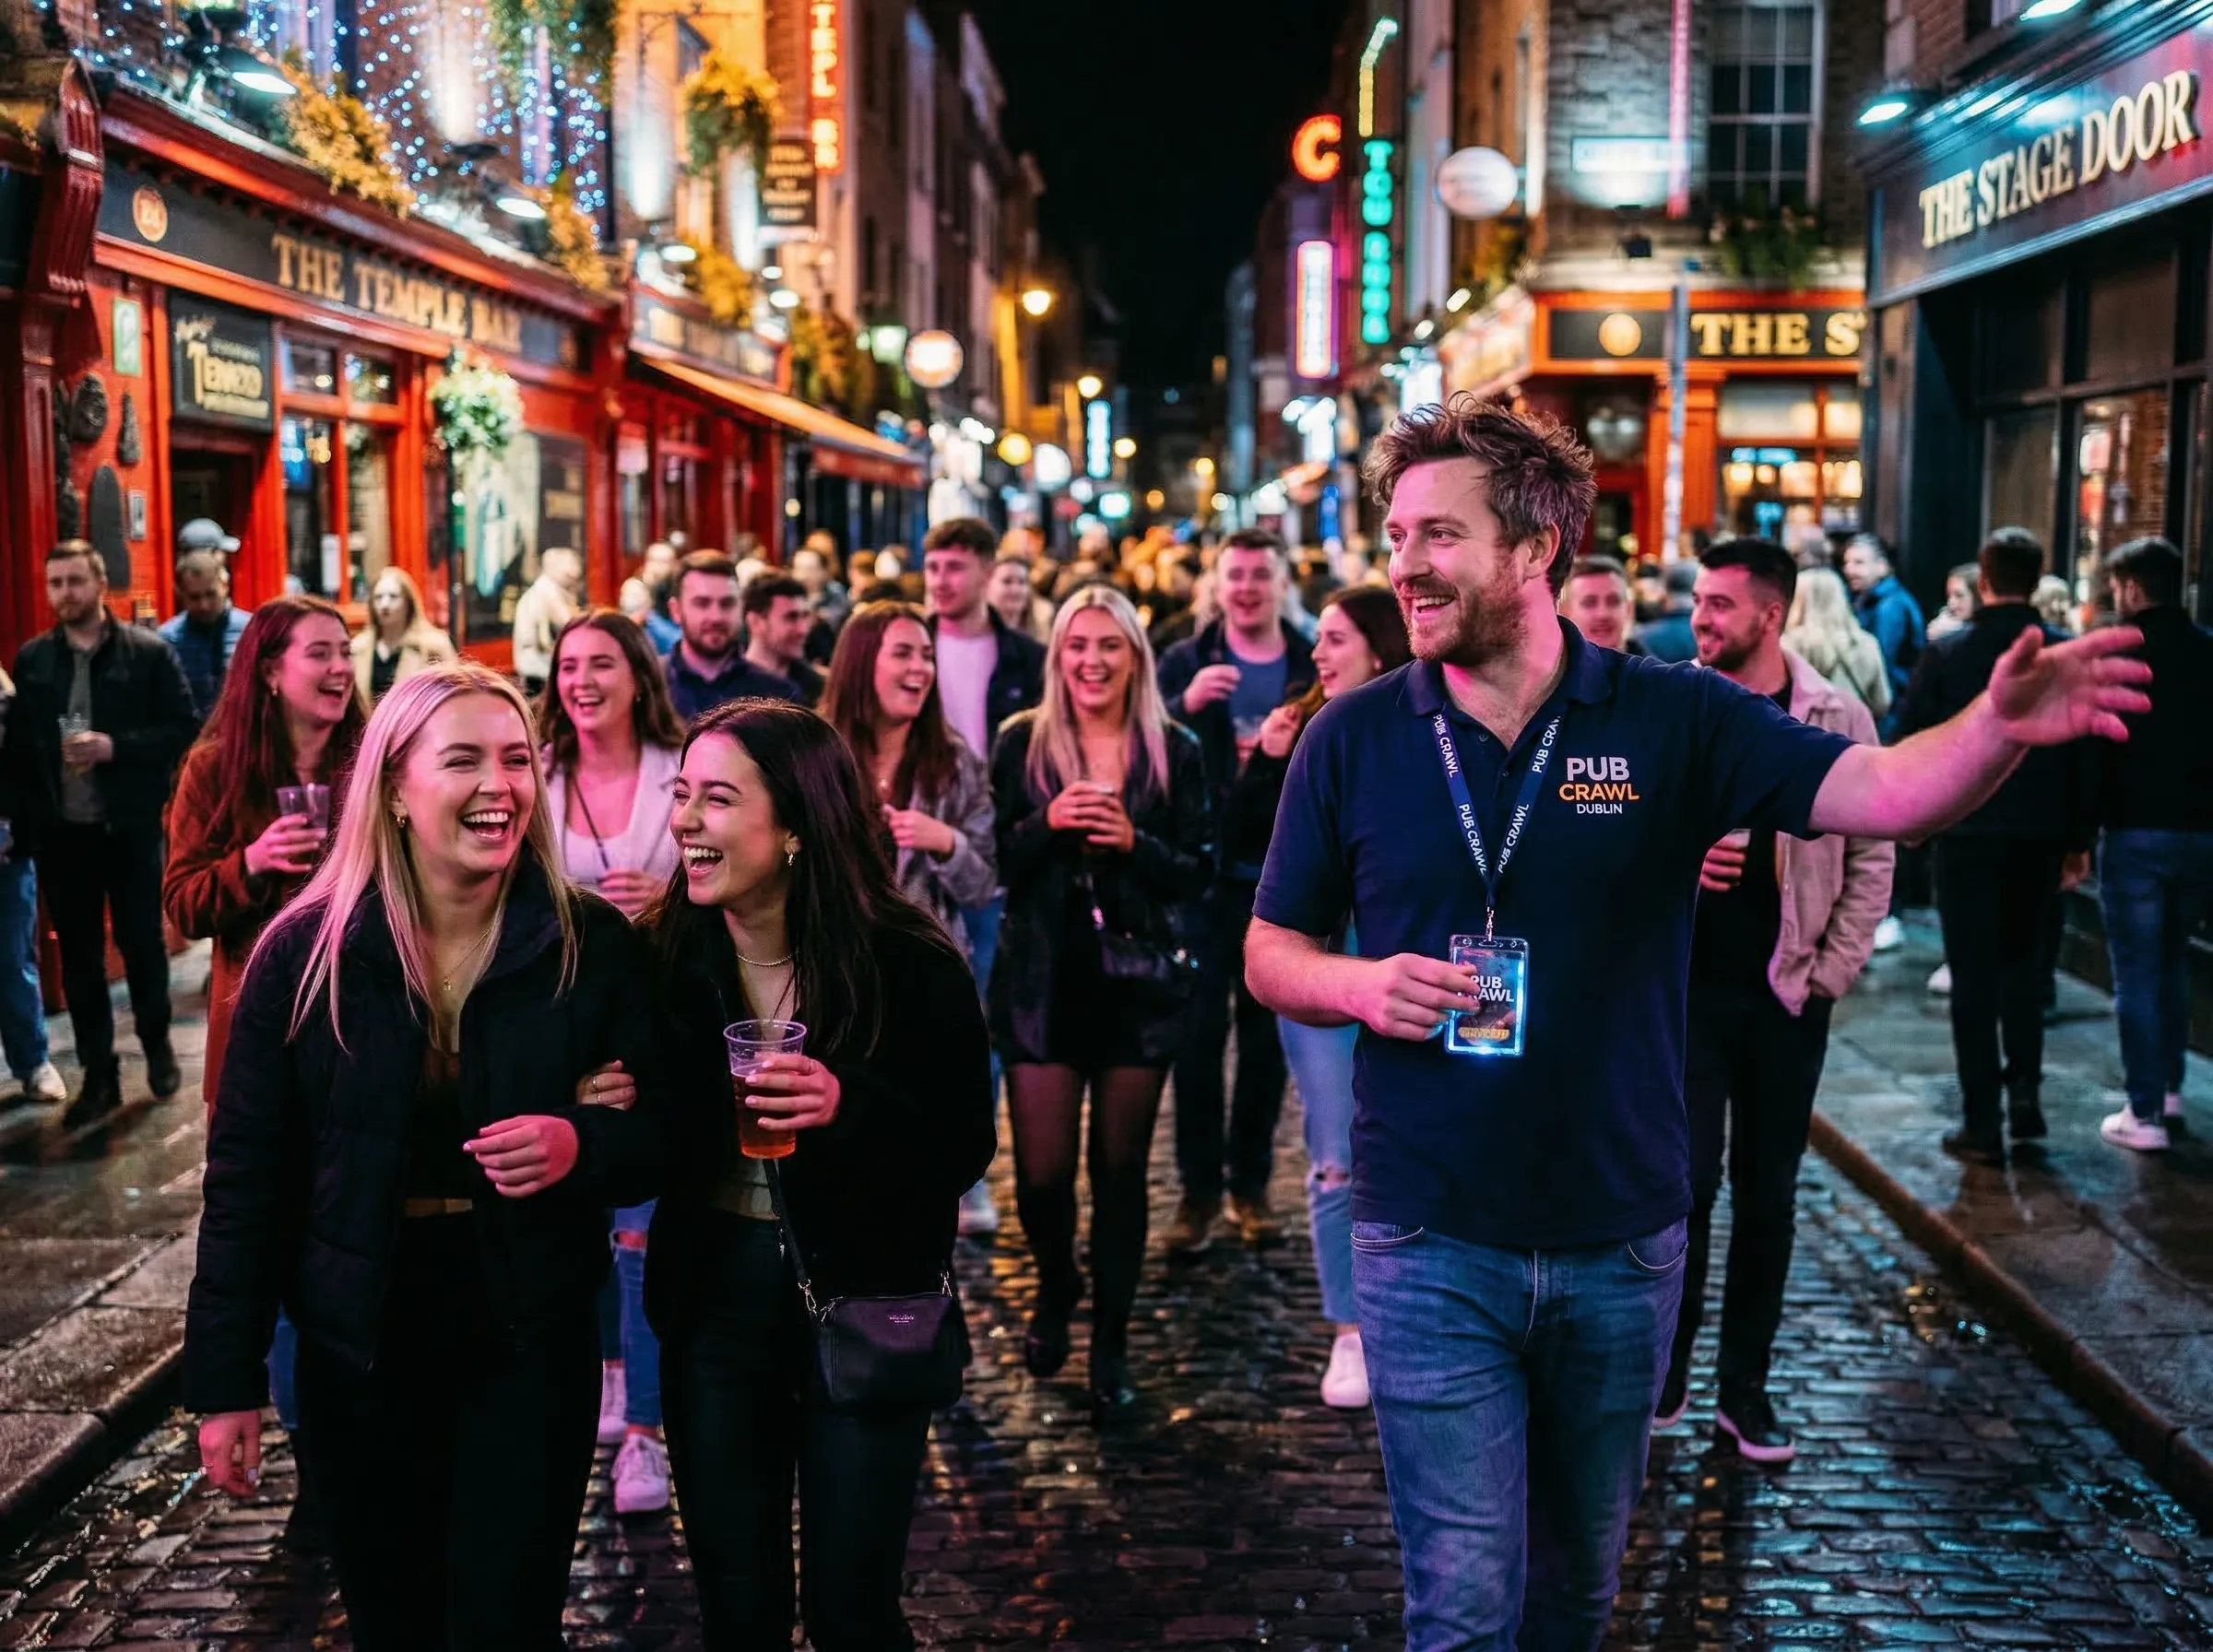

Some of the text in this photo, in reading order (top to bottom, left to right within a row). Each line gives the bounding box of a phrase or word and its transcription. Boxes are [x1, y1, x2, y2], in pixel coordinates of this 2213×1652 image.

[1919, 70, 2195, 249] THE STAGE DOOR
[272, 232, 345, 302] THE
[1690, 313, 1811, 356] THE
[1433, 714, 1459, 778] PUB CRAWL
[1532, 749, 1549, 773] PUB
[1567, 756, 1630, 782] PUB
[1558, 783, 1640, 801] CRAWL
[1576, 803, 1623, 815] DUBLIN
[1459, 803, 1487, 876] PUB CRAWL
[1497, 803, 1529, 874] PUB CRAWL
[1470, 975, 1503, 989] PUB
